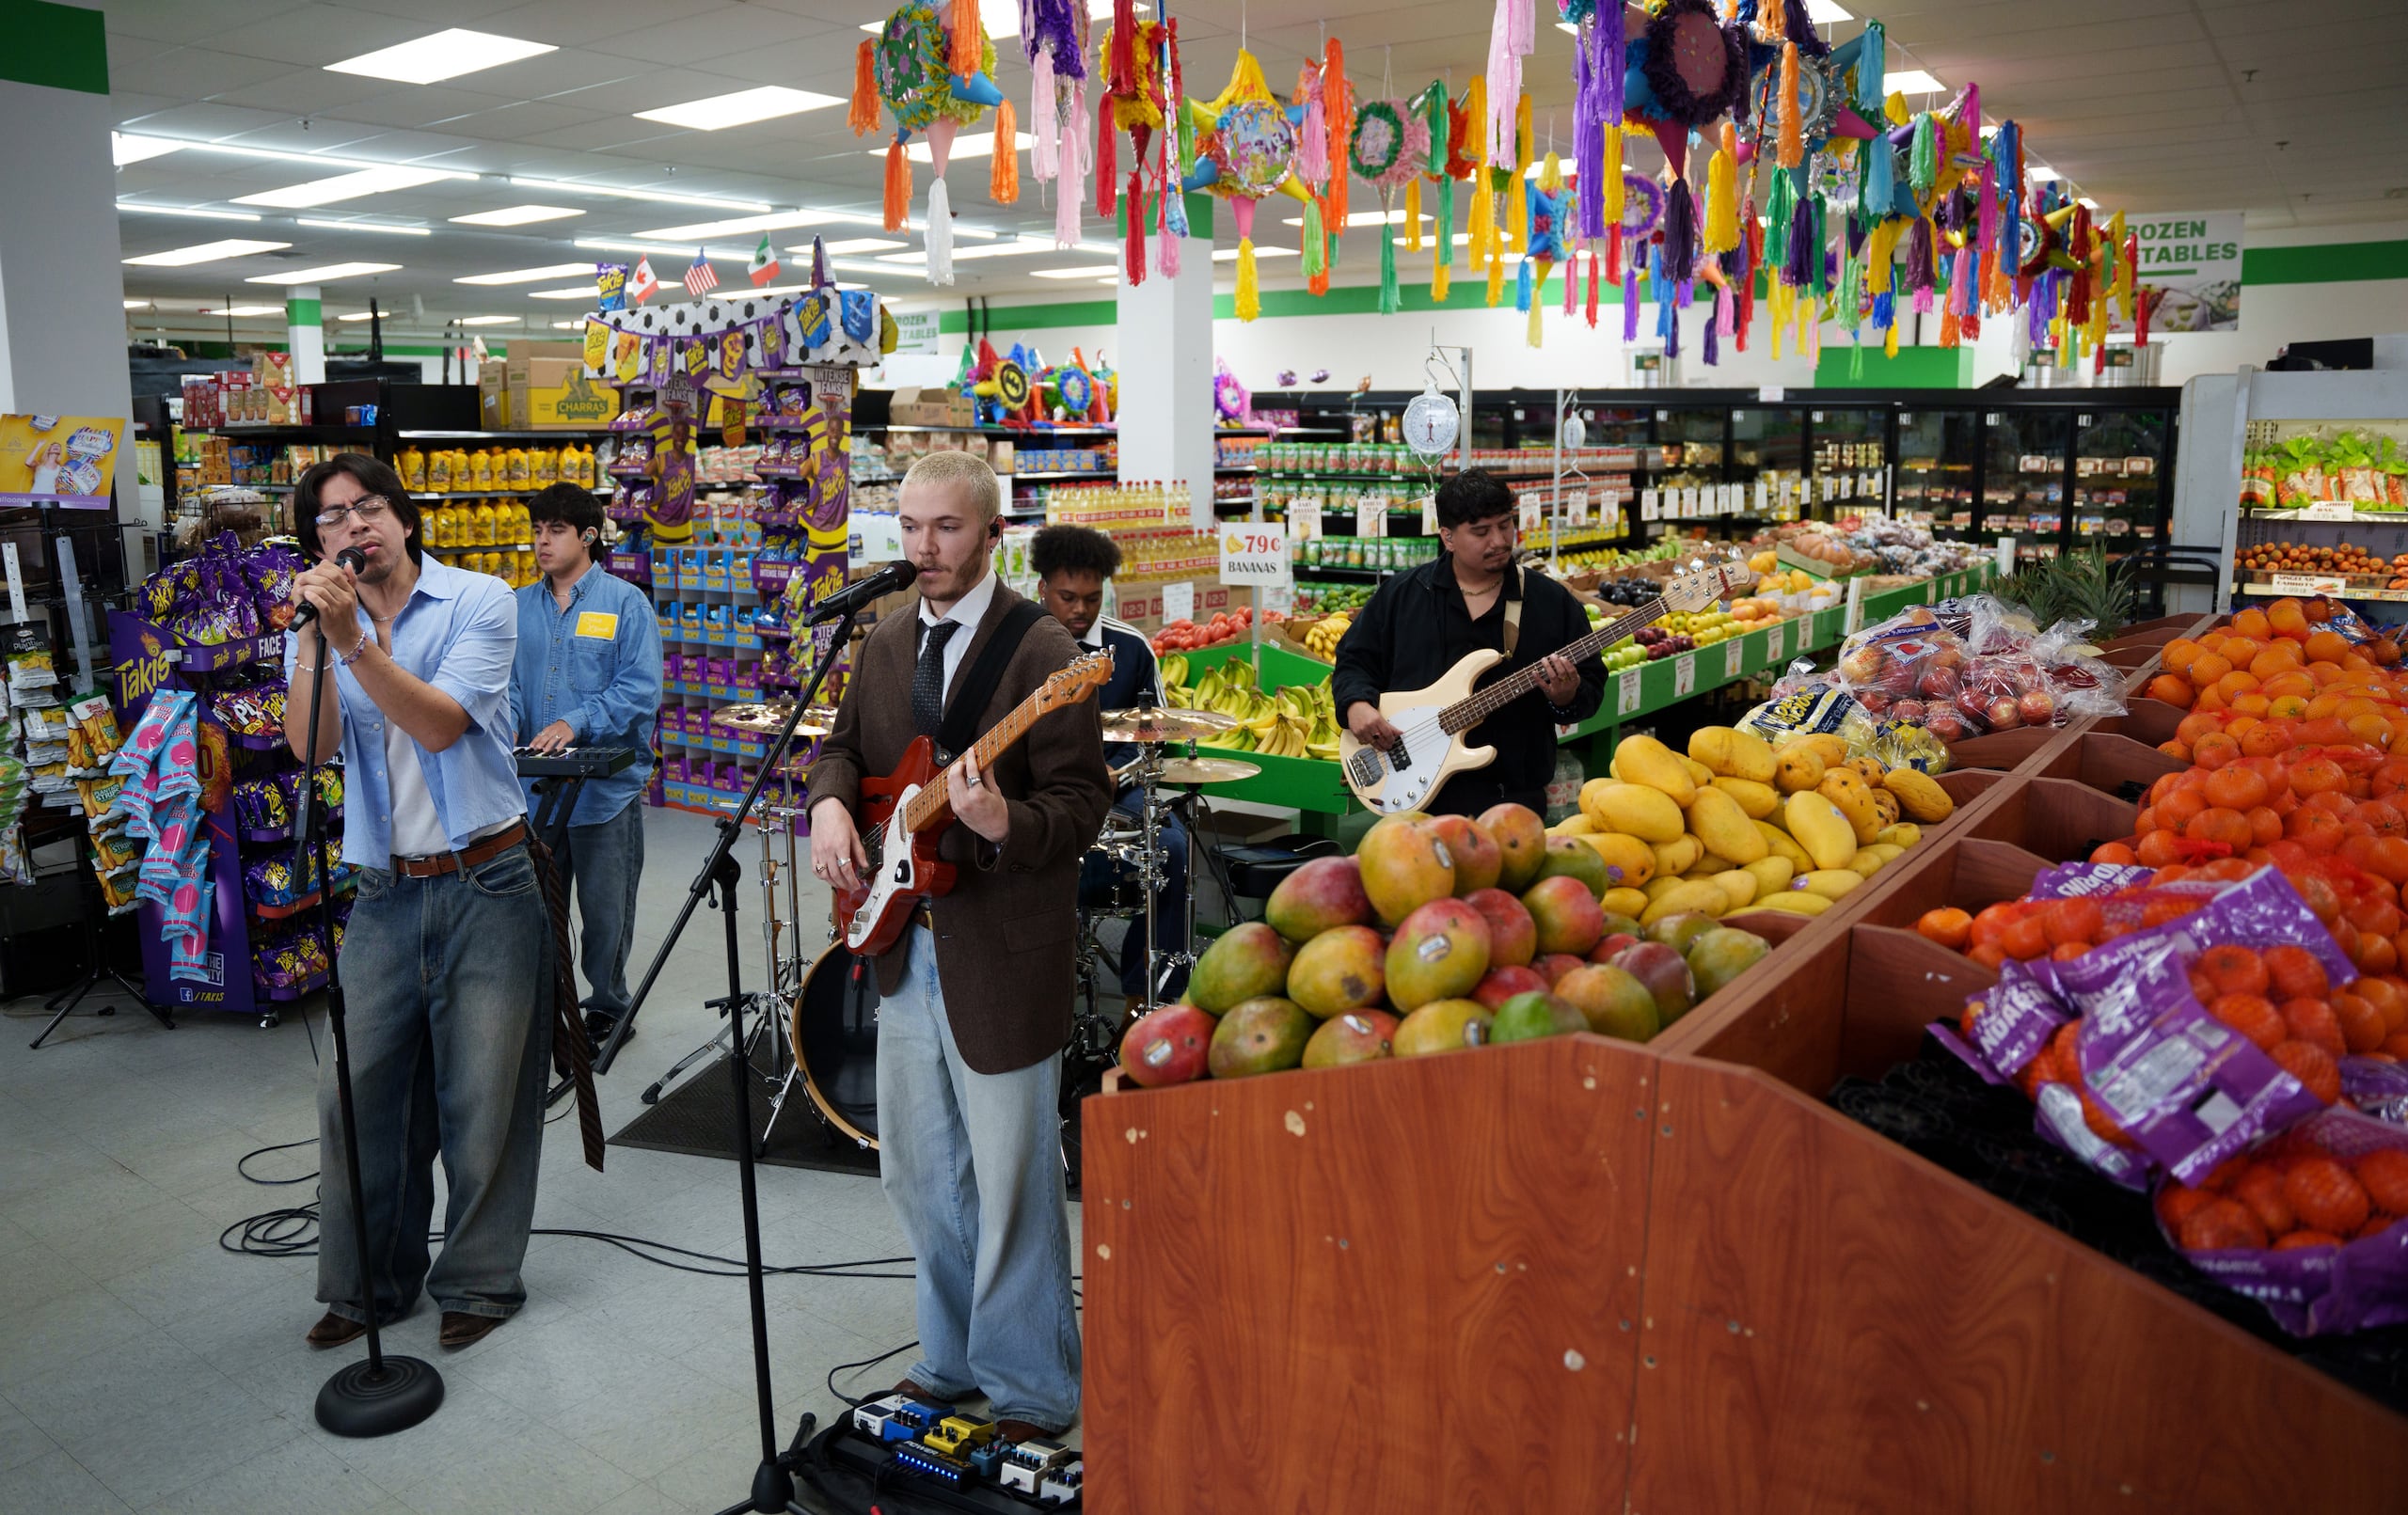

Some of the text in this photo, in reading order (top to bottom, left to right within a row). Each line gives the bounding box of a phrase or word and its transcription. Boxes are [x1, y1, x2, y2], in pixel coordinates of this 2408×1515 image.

[2124, 220, 2206, 240] ROZEN
[2138, 242, 2238, 263] TABLES
[895, 314, 927, 325] ROZEN
[667, 390, 689, 402] FANS
[820, 382, 845, 395] FANS
[559, 402, 607, 414] CHARRAS
[665, 468, 690, 502] Takis
[820, 468, 846, 505] Takis
[1228, 560, 1277, 574] BANANAS
[811, 571, 844, 605] Takis
[1208, 592, 1227, 605] 123
[1123, 604, 1145, 617] 123
[13, 639, 44, 651] Plantain
[258, 635, 282, 658] FACE
[213, 642, 251, 671] Takis Takis
[115, 649, 170, 709] Takis
[95, 790, 121, 802] STRIPS
[904, 1440, 939, 1456] POWER
